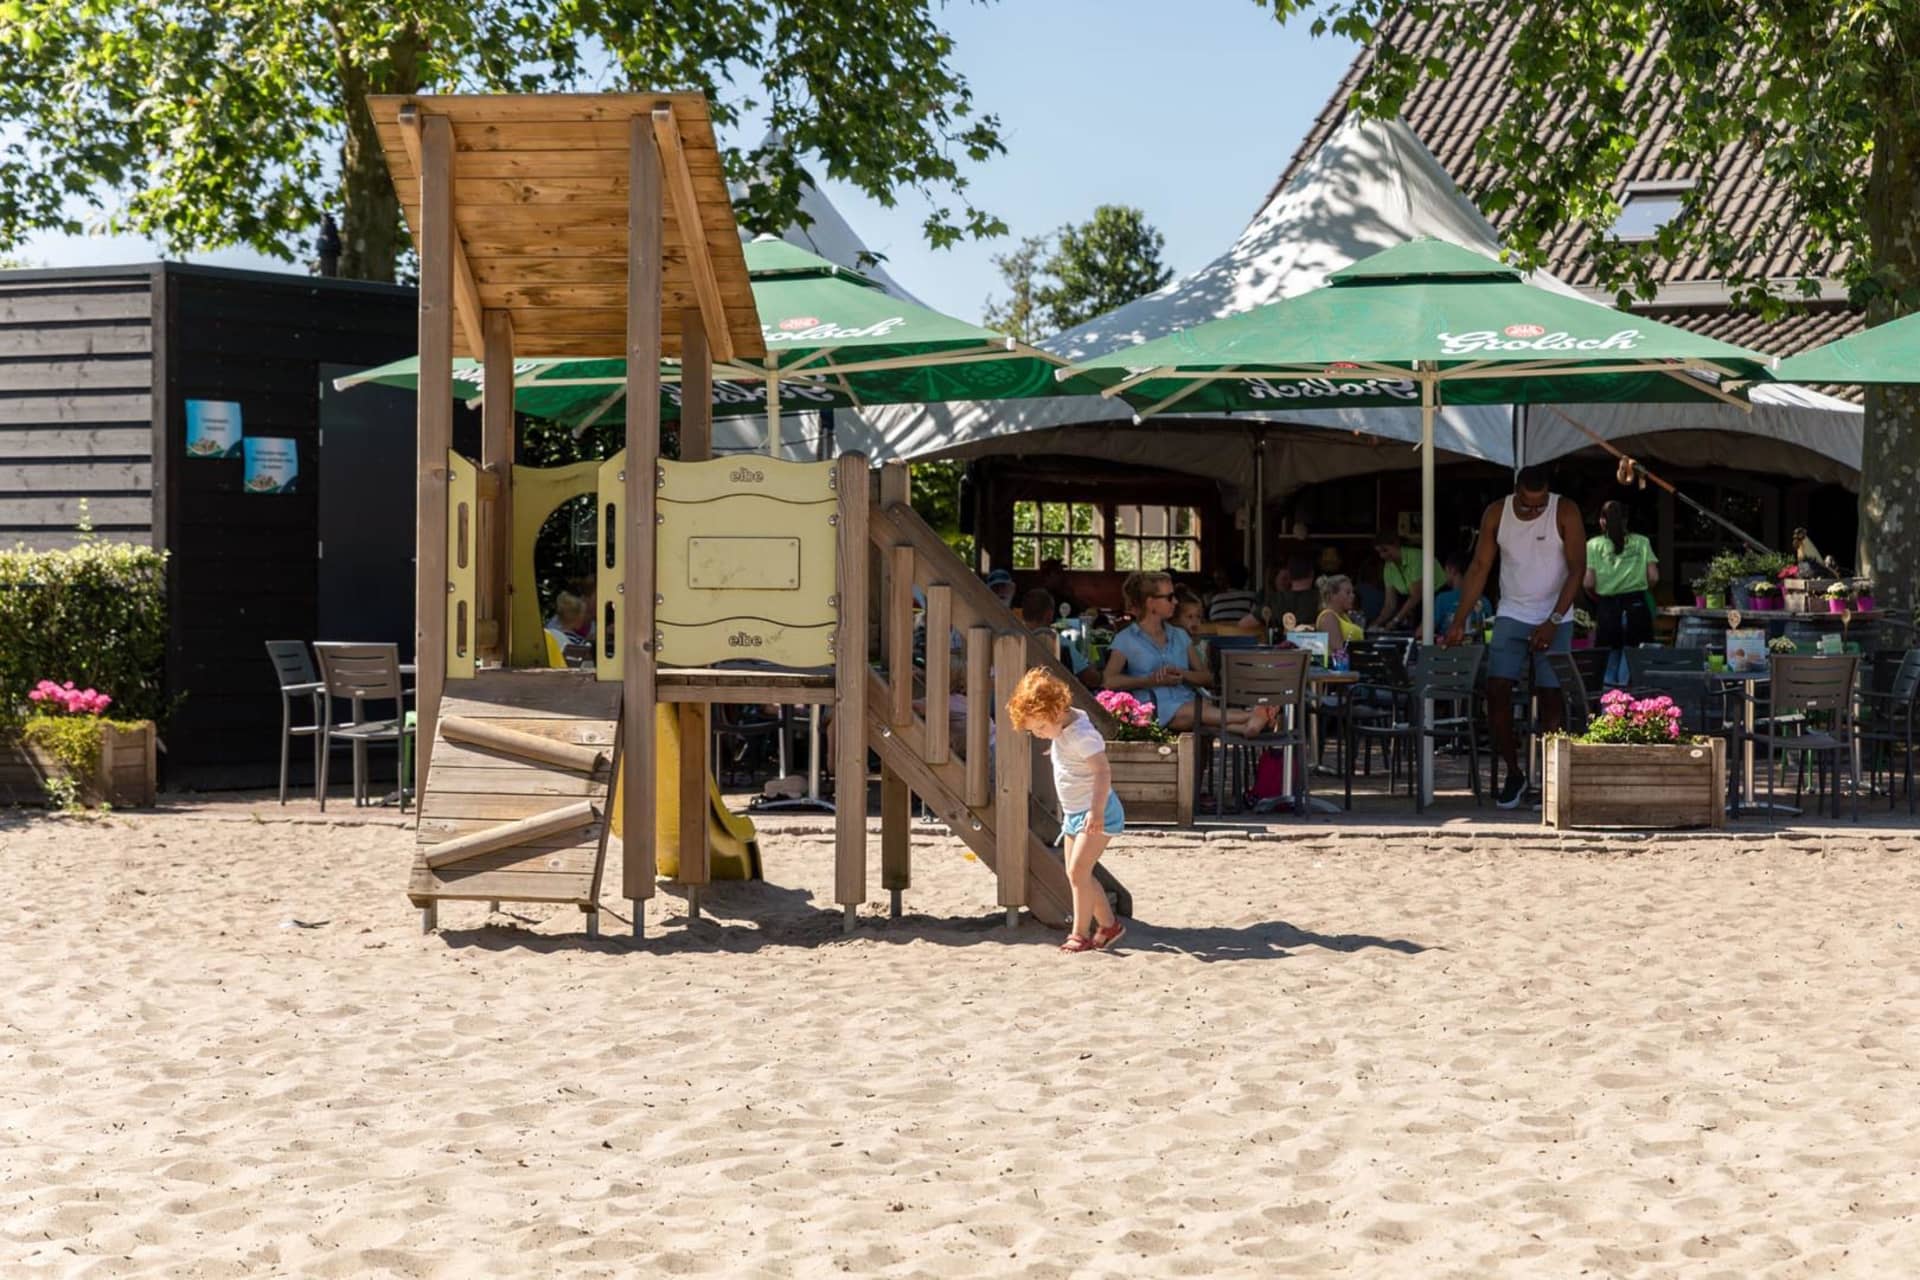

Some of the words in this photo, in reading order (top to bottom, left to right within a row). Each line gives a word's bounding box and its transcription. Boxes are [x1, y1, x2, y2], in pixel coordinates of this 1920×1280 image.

[1437, 329, 1642, 354] Grolsch
[729, 466, 764, 483] eibe
[728, 631, 762, 647] eibe
